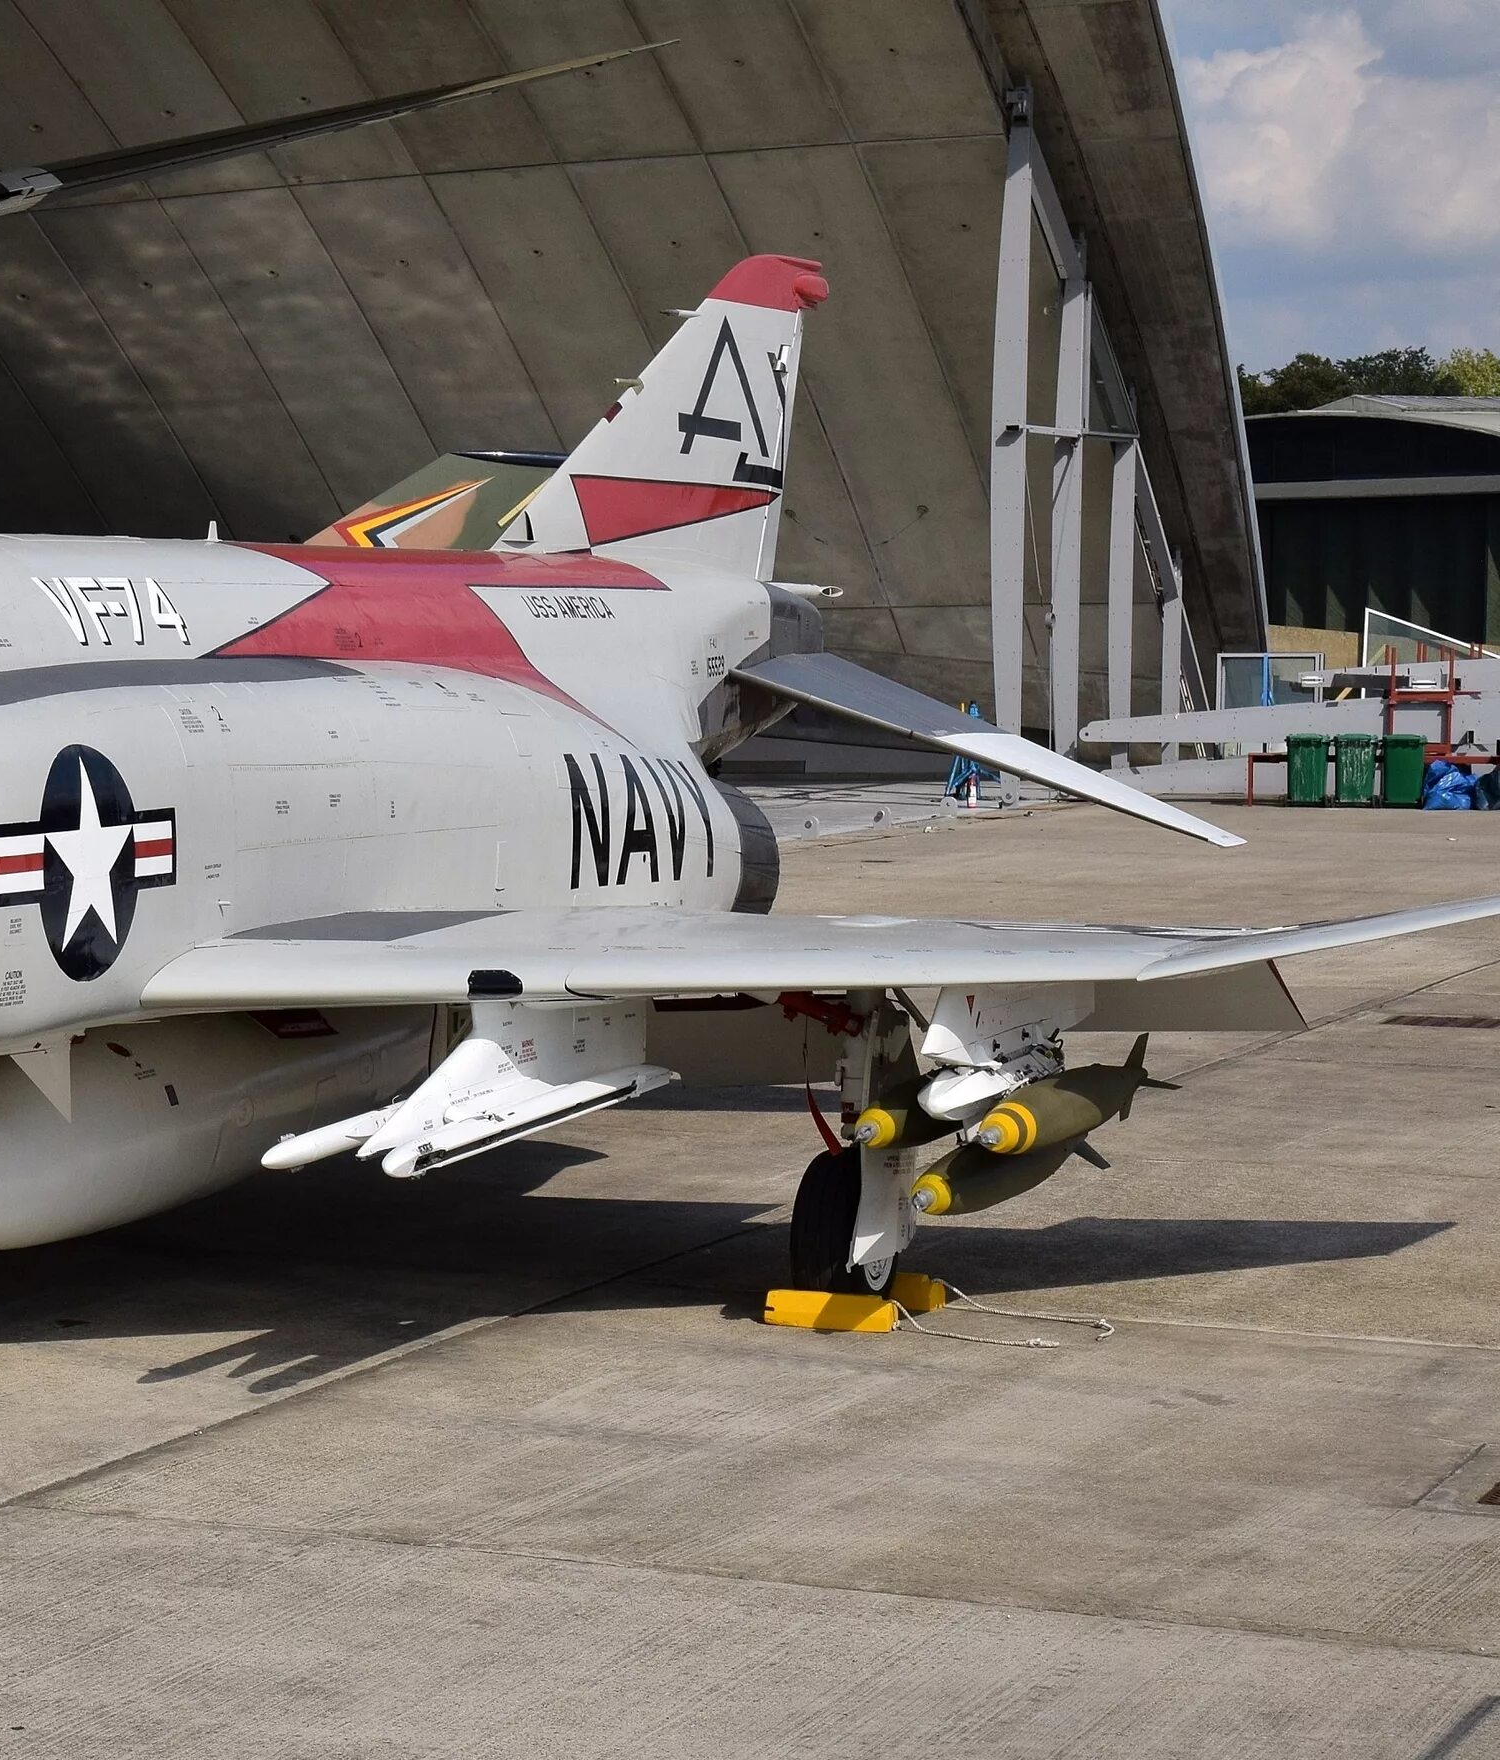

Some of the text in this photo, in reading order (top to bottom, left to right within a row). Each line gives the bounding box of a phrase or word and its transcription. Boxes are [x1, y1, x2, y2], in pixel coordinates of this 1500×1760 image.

[31, 577, 191, 646] VF-74
[521, 596, 616, 618] USS AMERICA
[563, 753, 714, 890] NAVY
